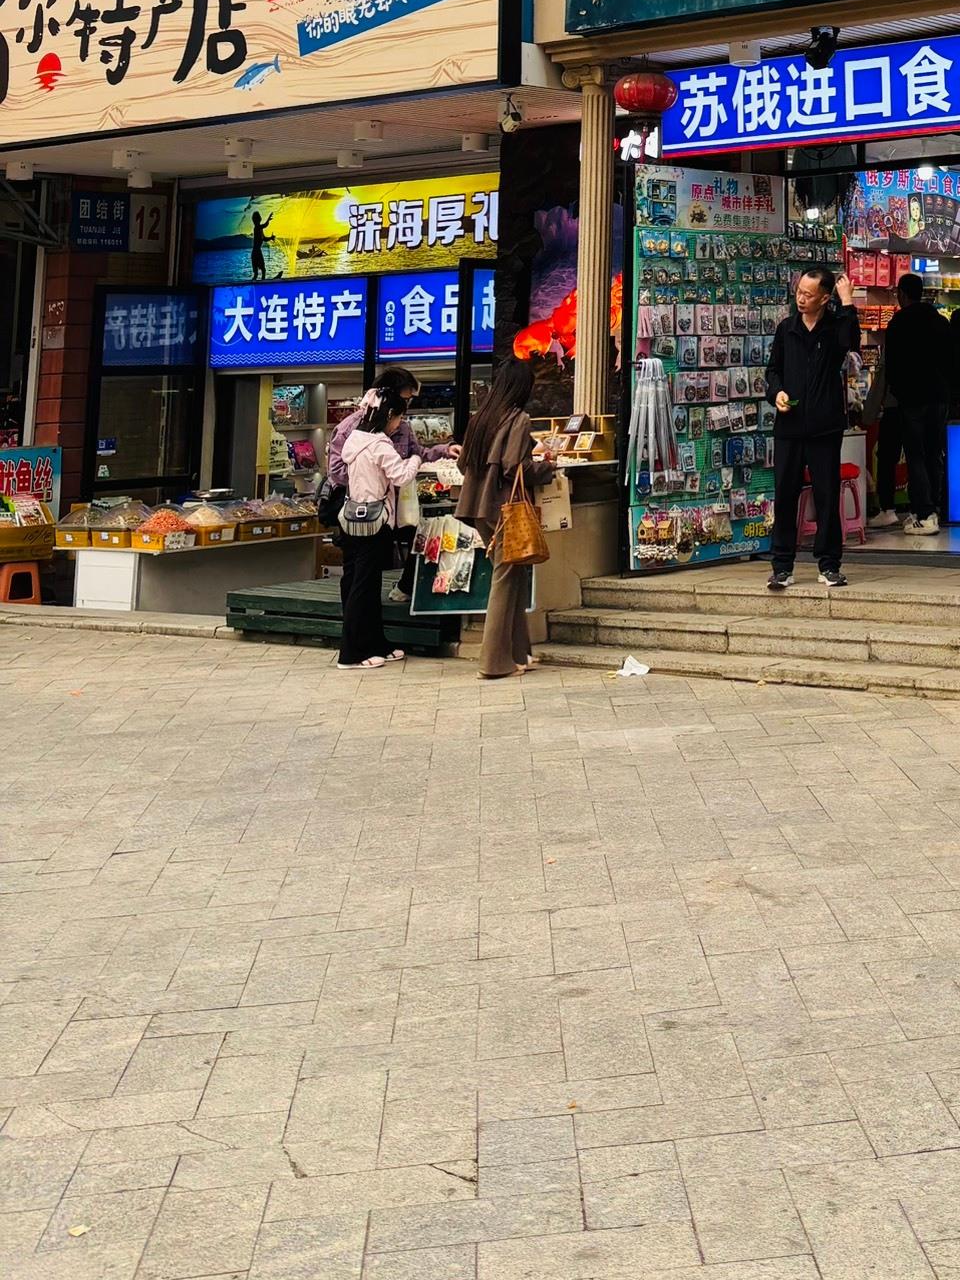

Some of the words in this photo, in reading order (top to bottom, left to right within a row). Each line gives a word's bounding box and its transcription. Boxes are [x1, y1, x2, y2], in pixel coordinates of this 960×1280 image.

[79, 198, 125, 221] 团结街
[135, 204, 161, 241] 12
[347, 191, 498, 253] 深海厚礼
[223, 289, 364, 343] 大连特产
